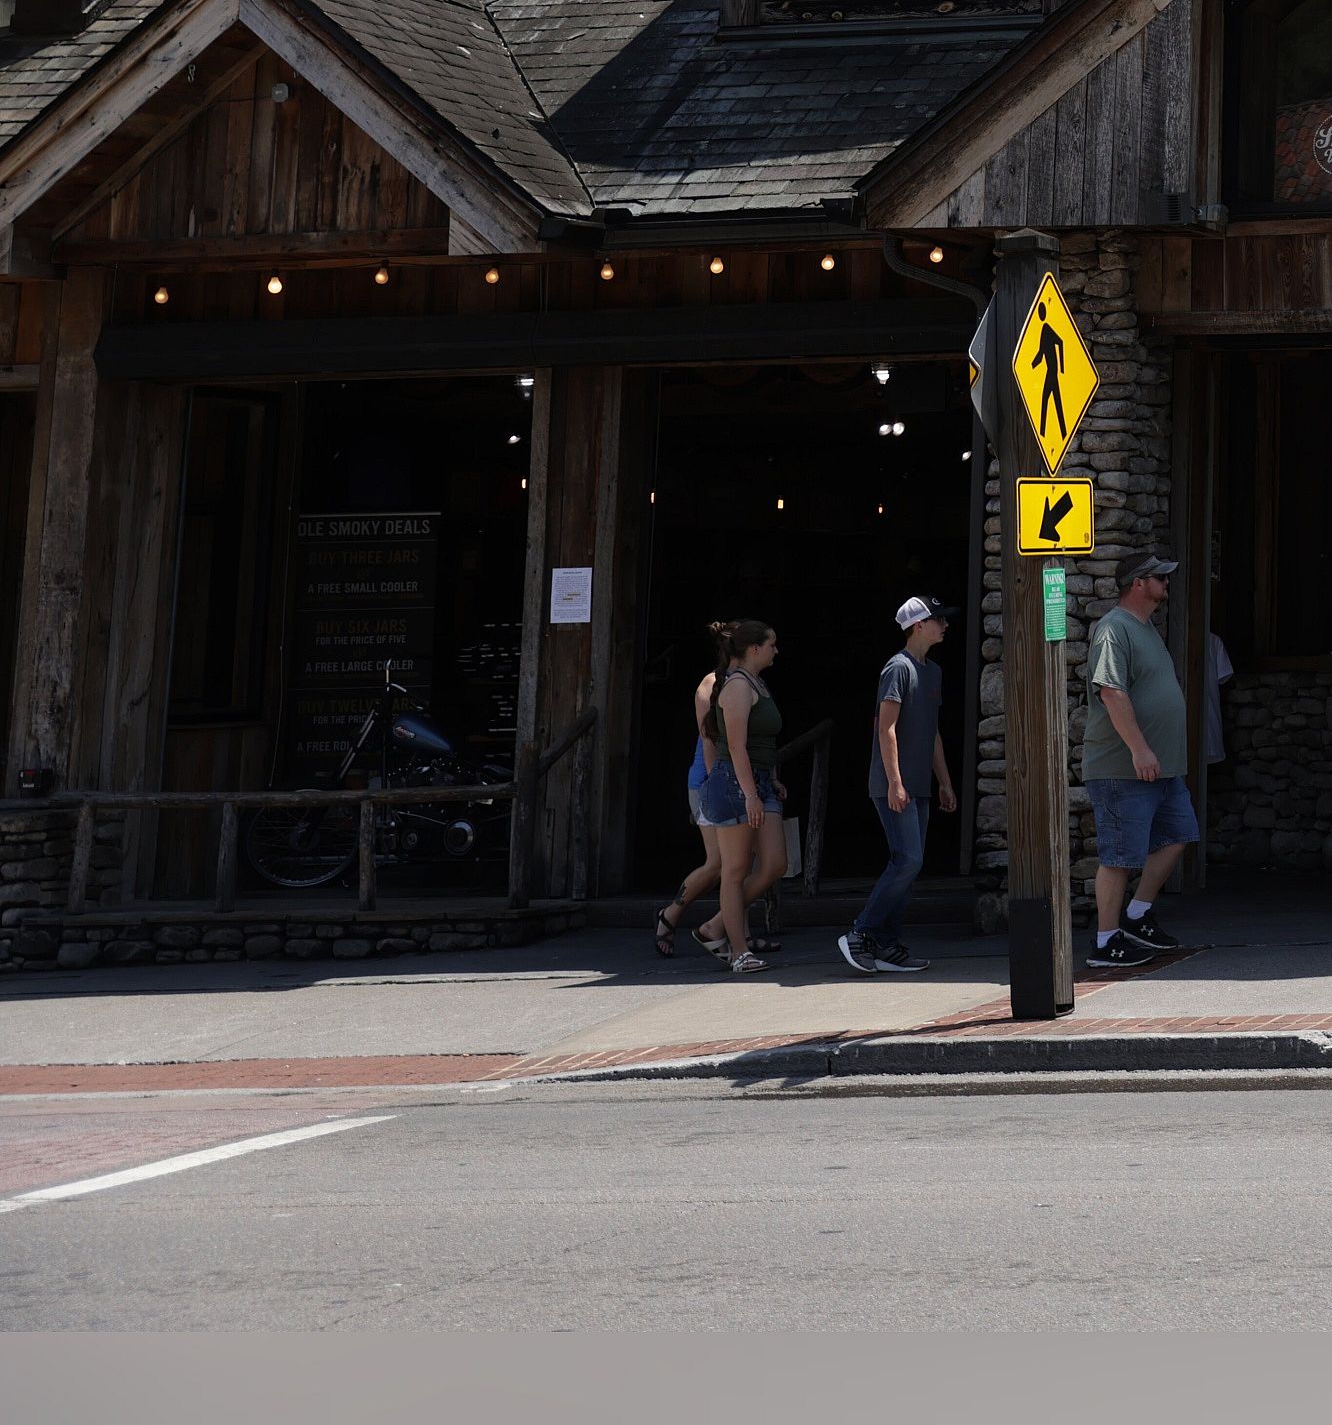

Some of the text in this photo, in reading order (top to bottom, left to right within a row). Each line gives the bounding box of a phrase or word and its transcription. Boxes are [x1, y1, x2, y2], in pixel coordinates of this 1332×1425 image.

[298, 519, 431, 536] OLE SMOKY DEALS
[342, 550, 384, 565] THREE
[385, 548, 419, 564] JARS
[307, 581, 418, 594] A FREE SMALL COOLER
[374, 619, 408, 633] JARS
[350, 635, 375, 645] PRICE
[388, 634, 407, 644] FIVE
[304, 663, 313, 673] A
[315, 662, 339, 672] FREE
[341, 661, 373, 672] LARGE
[391, 698, 416, 712] ARS
[347, 715, 369, 725] PRIC
[306, 742, 331, 752] FREE
